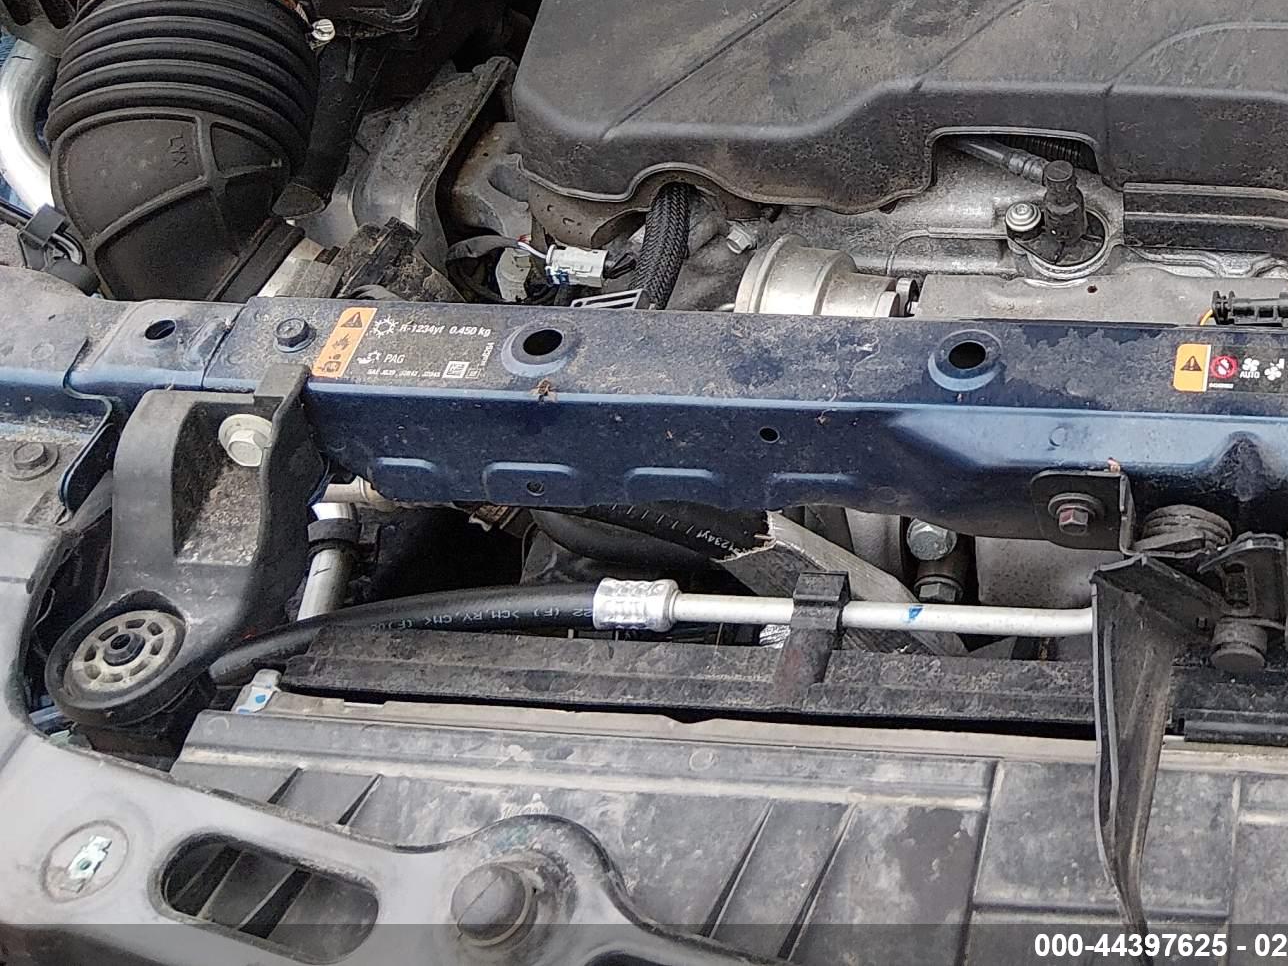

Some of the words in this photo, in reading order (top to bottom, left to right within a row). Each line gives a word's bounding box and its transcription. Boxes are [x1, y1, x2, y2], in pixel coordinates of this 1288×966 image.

[399, 324, 445, 335] R-1234yf
[449, 326, 477, 335] 0.450
[478, 326, 492, 337] kg
[383, 353, 406, 364] PAG
[1240, 371, 1260, 379] AUTO
